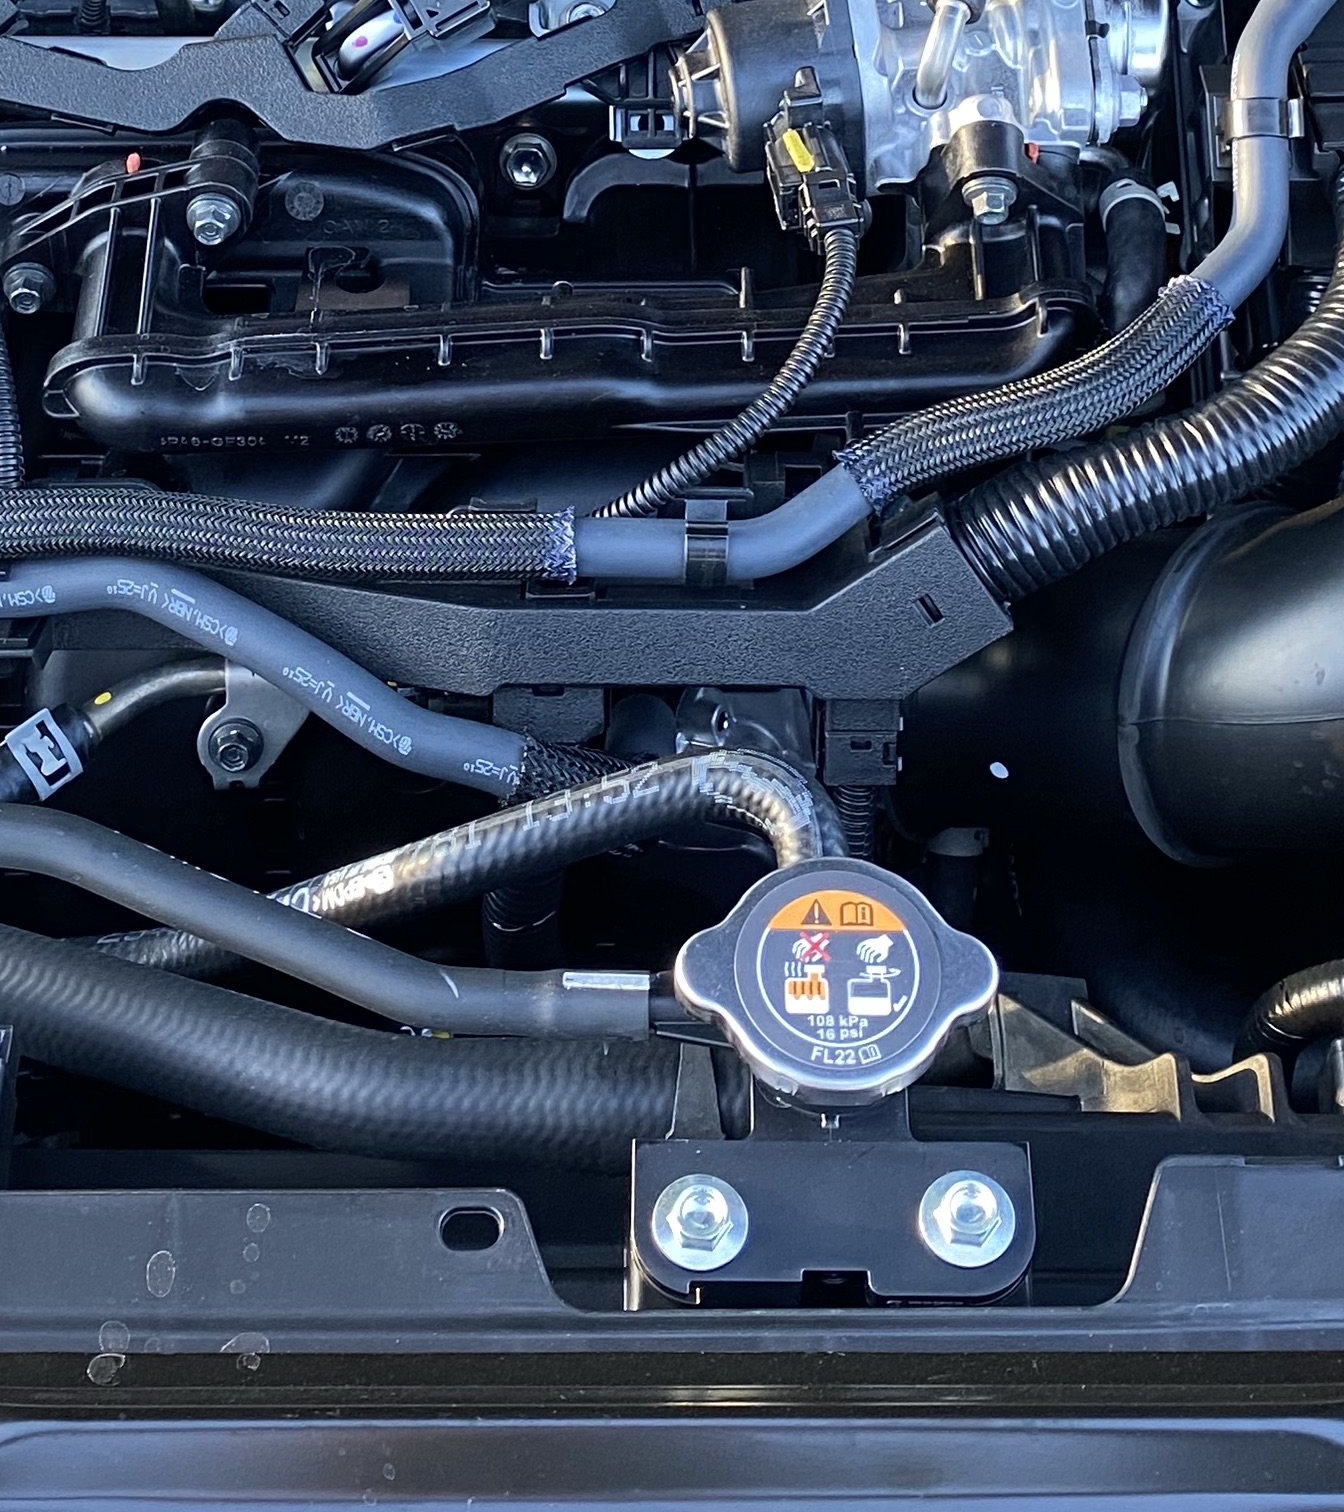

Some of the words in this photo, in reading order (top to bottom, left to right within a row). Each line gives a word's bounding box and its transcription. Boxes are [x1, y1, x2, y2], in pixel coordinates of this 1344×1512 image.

[807, 1015, 834, 1027] 108
[839, 1015, 869, 1028] kPa
[816, 1029, 836, 1040] 16
[840, 1026, 864, 1041] psi
[810, 1046, 857, 1066] FL22
